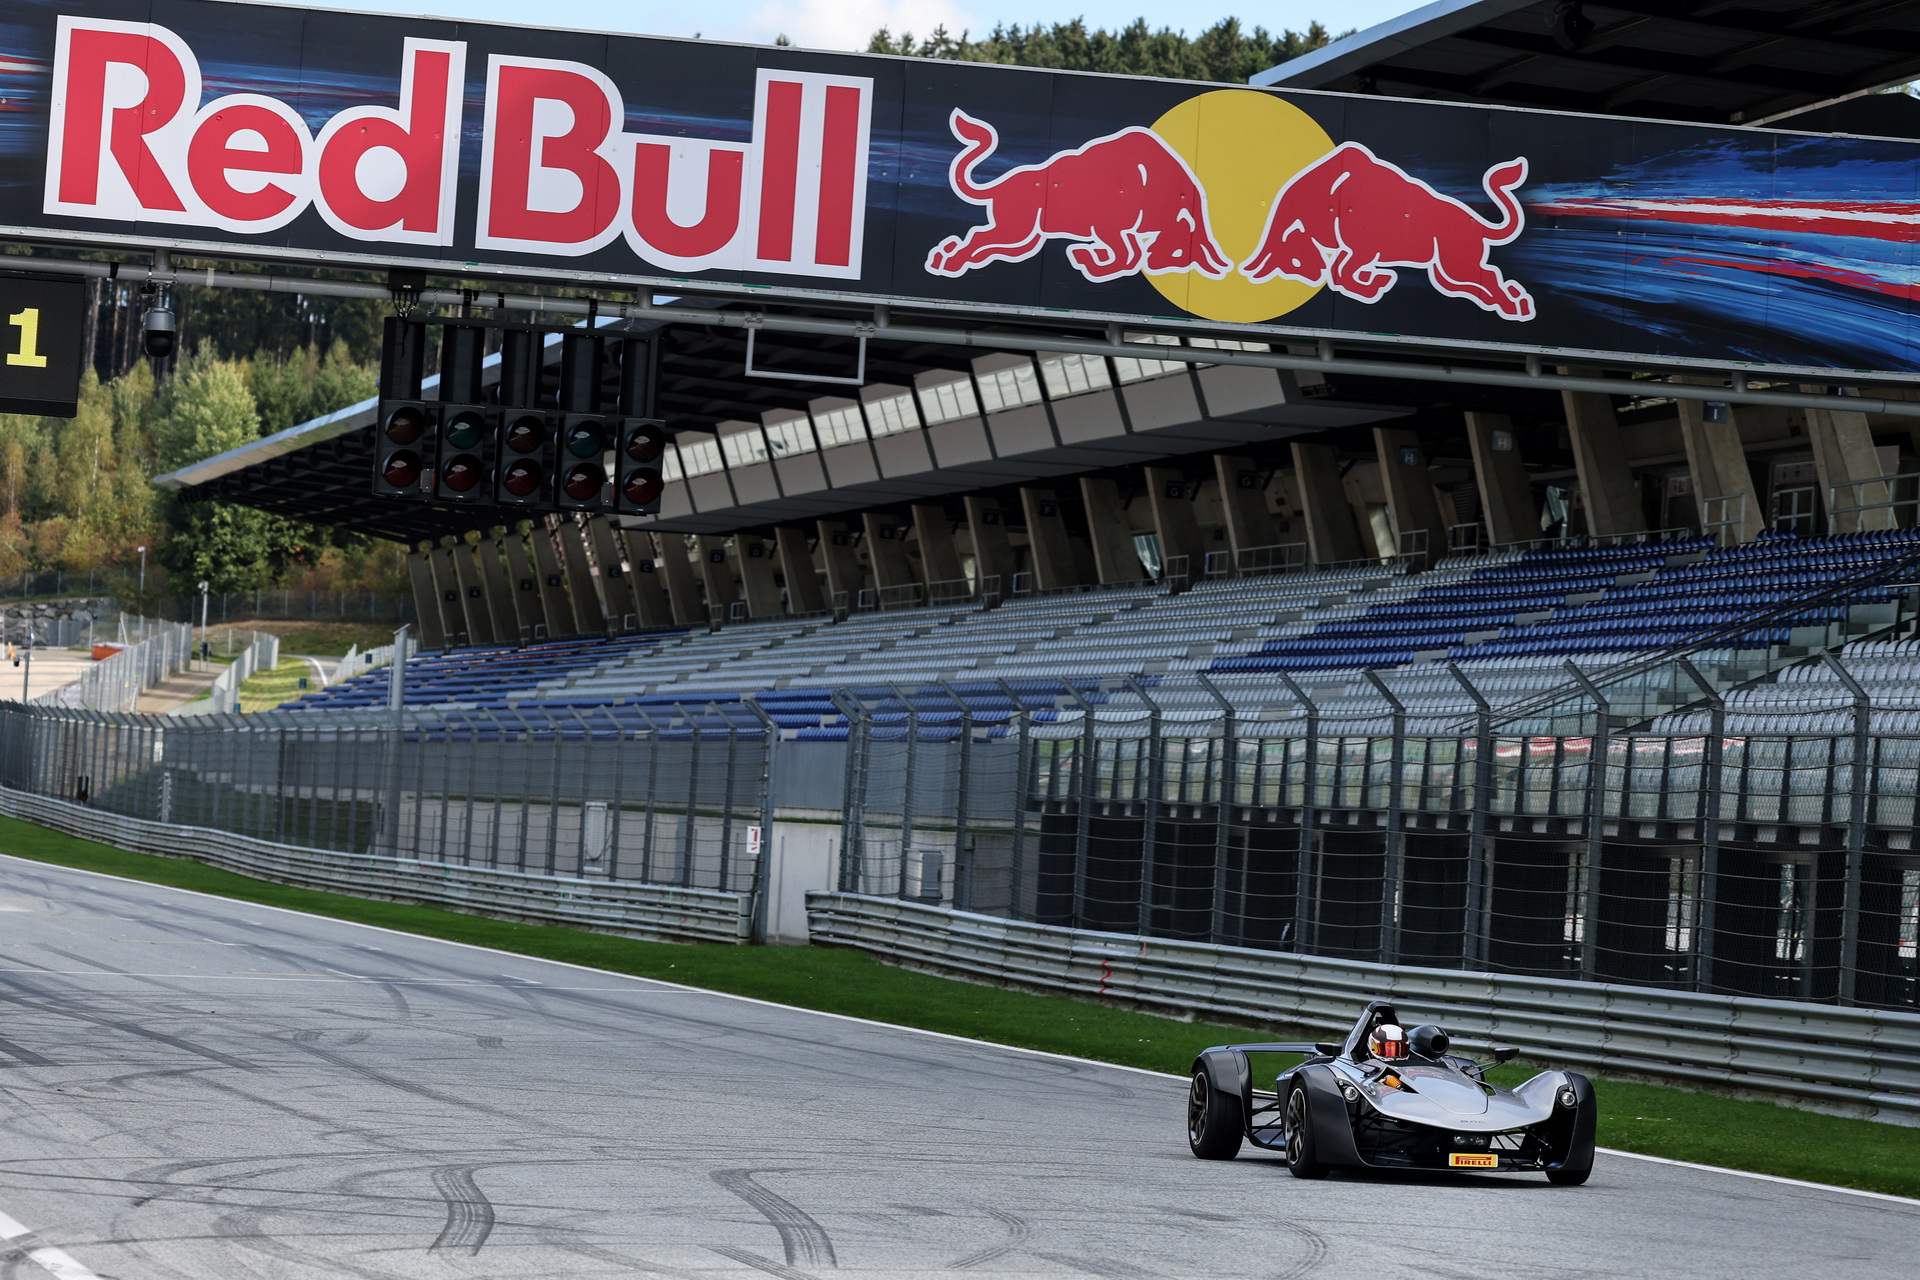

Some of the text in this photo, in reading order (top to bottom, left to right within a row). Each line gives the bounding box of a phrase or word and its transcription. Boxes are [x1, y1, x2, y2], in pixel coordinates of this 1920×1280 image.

[49, 20, 867, 274] Red Bull
[6, 307, 48, 368] 1
[1498, 438, 1507, 448] H
[1405, 453, 1414, 463] H
[1242, 476, 1252, 487] G
[1170, 487, 1180, 497] G
[1044, 506, 1053, 515] F
[1455, 1156, 1492, 1166] PIRELLI
